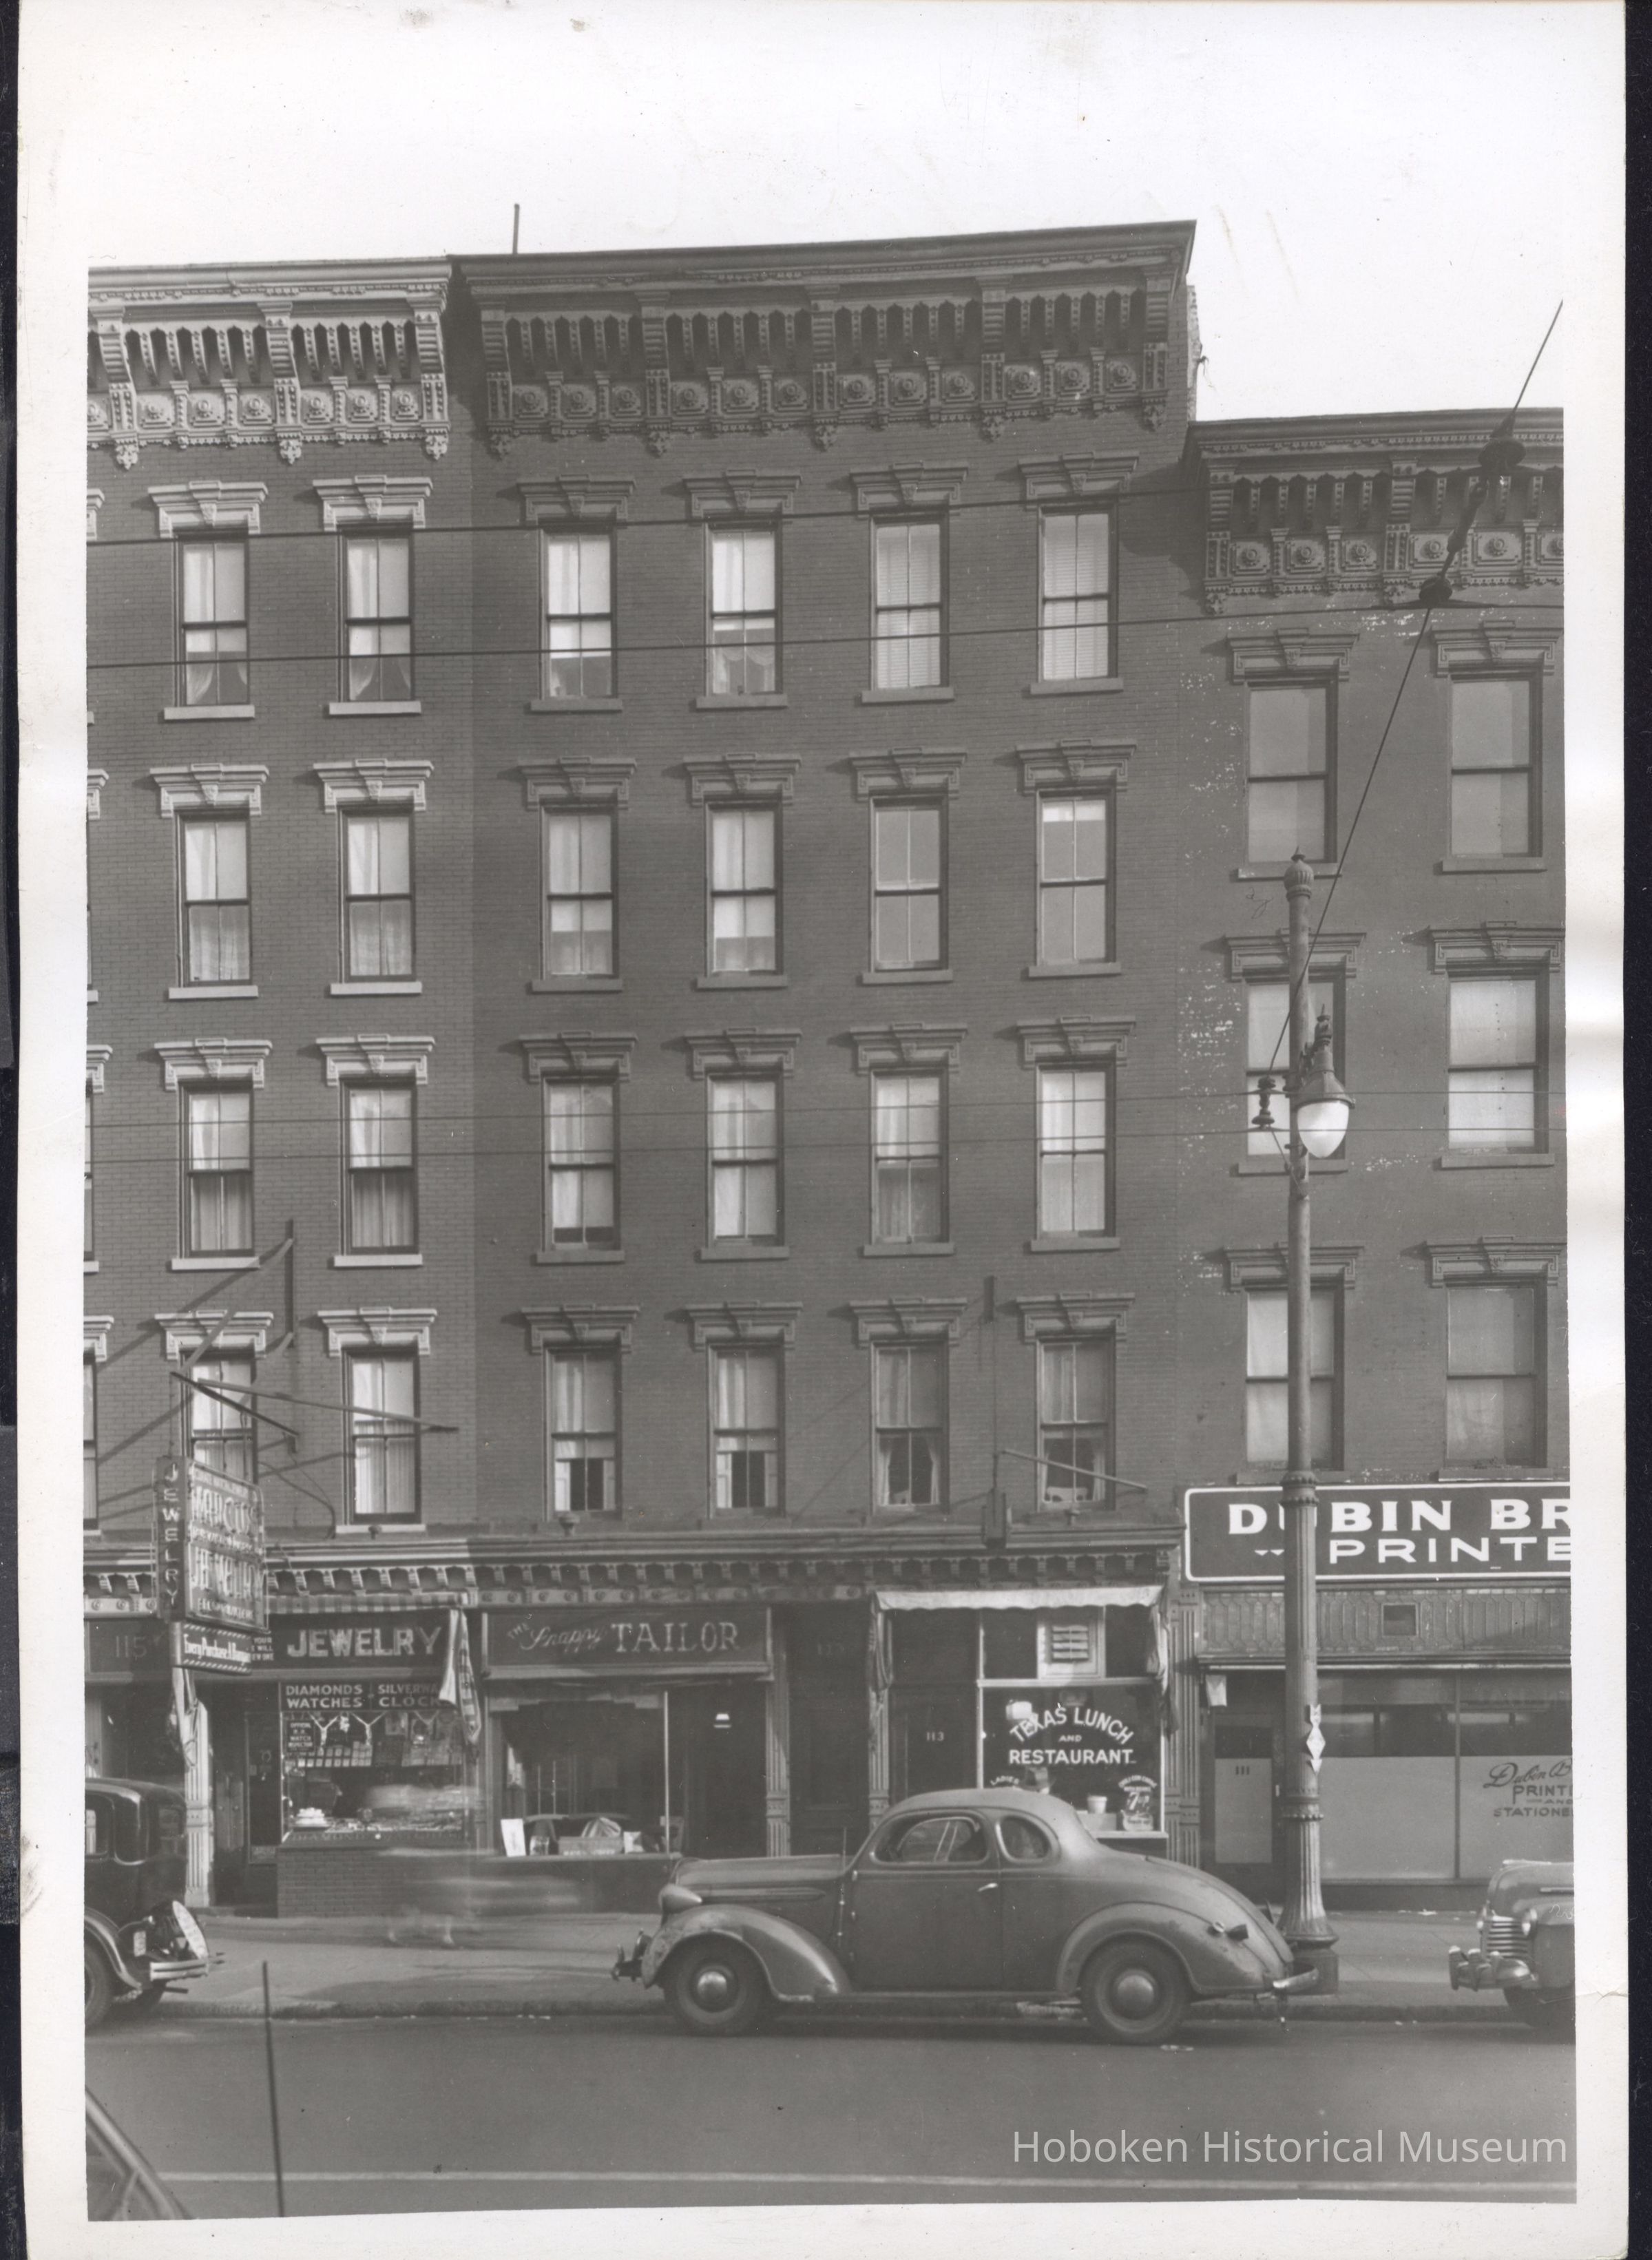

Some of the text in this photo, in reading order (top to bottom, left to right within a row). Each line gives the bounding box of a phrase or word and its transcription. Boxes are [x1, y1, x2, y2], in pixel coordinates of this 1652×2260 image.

[1228, 1500, 1452, 1534] DBIN
[161, 1463, 181, 1607] JEWELRY
[1329, 1536, 1571, 1564] PRINTE
[115, 1635, 147, 1659] 115
[287, 1626, 441, 1657] JEWELRY
[507, 1622, 530, 1639] THE
[611, 1621, 740, 1653] TAILOR
[286, 1683, 439, 1695] DIAMONDS SILVERWA
[286, 1697, 363, 1708] WATCHES
[1010, 1706, 1134, 1744] TEXAS LUNCH
[926, 1732, 944, 1741] 113
[1009, 1749, 1133, 1764] RESTAURANT
[990, 1775, 1019, 1786] LADIES
[1512, 1784, 1573, 1804] PRINT
[1493, 1807, 1573, 1817] STATIONE
